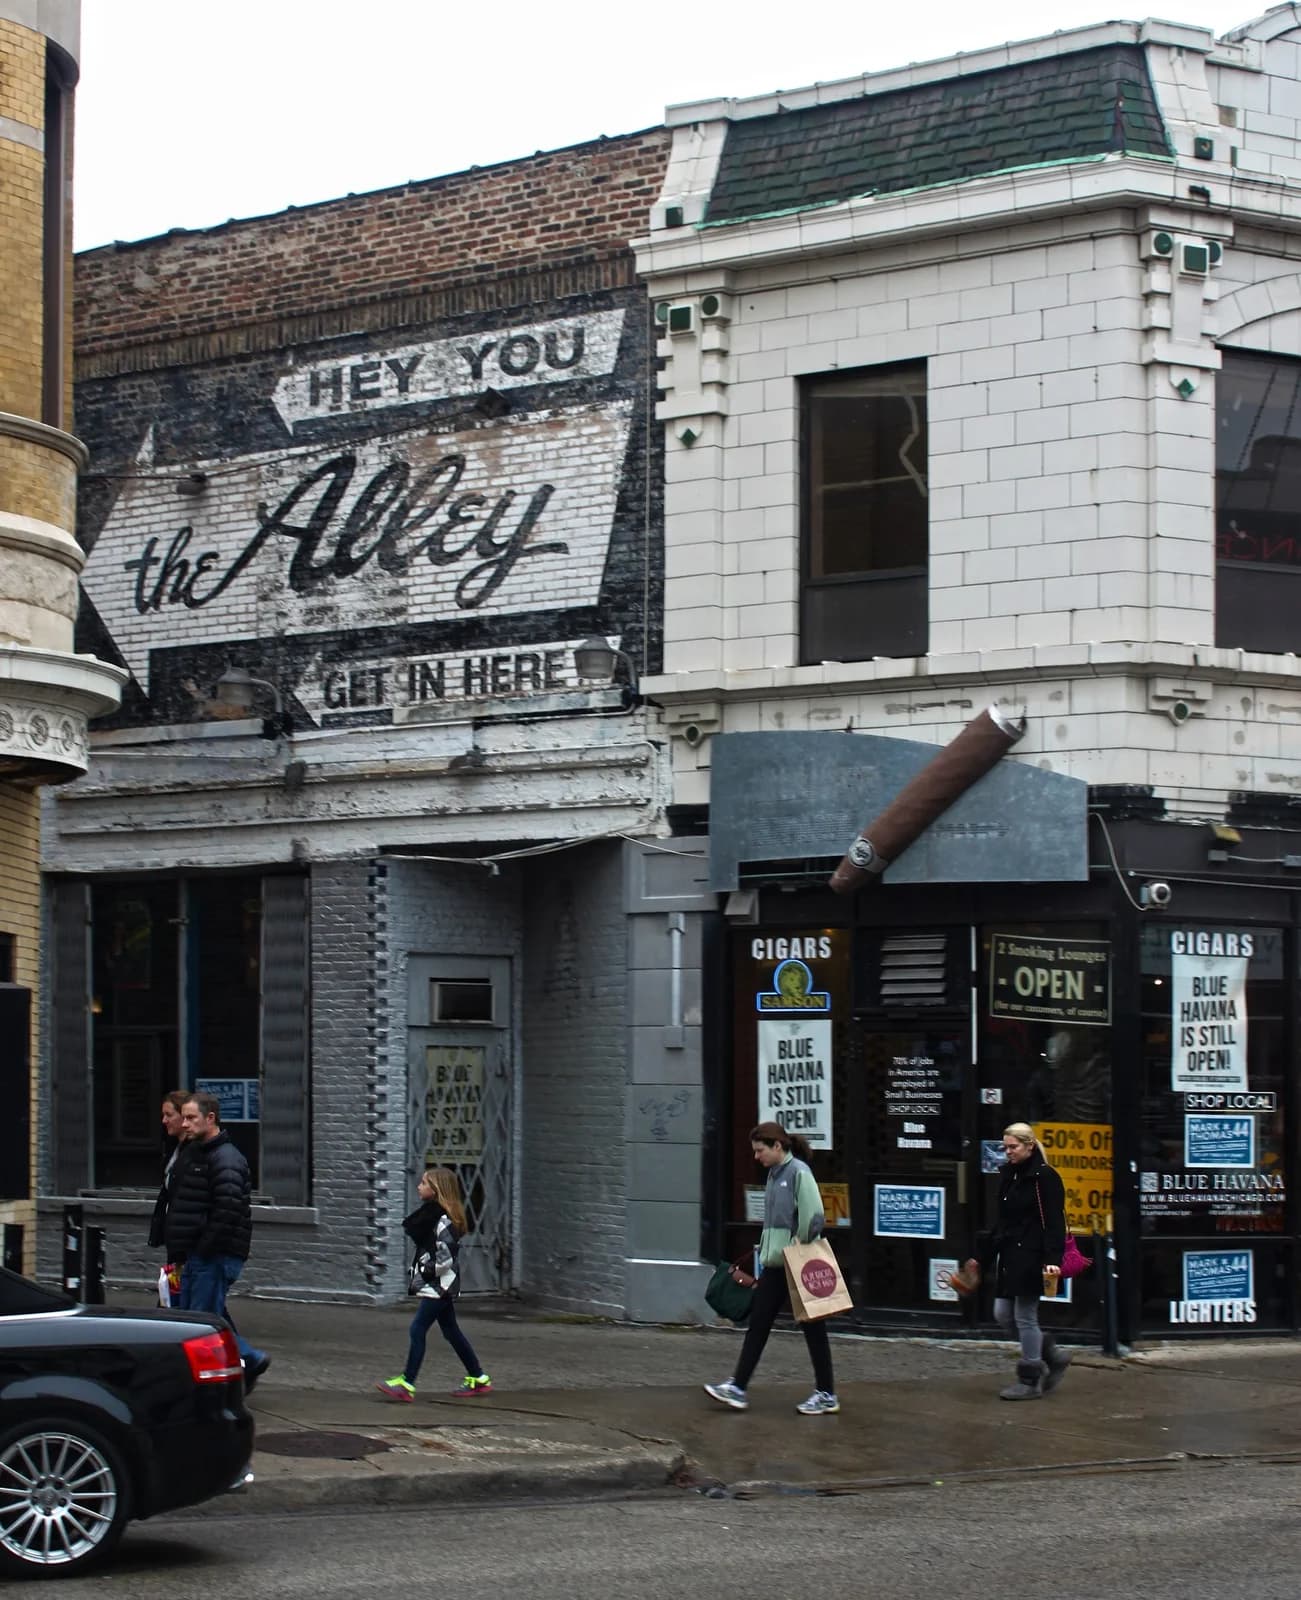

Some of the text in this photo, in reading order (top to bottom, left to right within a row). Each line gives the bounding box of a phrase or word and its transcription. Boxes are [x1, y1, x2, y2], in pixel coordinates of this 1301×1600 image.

[308, 327, 587, 408] HEY YOU
[124, 453, 570, 615] the Alley
[324, 665, 394, 710] GET
[409, 660, 446, 701] IN
[751, 936, 832, 960] CIGARS
[997, 942, 1107, 963] 2 Smoking Lounges
[1171, 930, 1254, 956] CIGARS
[1014, 966, 1085, 1000] OPEN
[1193, 976, 1228, 997] BLUE
[1181, 1000, 1237, 1022] HAVANA
[1181, 1024, 1236, 1047] IS STILL
[778, 1037, 814, 1060] BLUE
[767, 1060, 824, 1084] HAVANA
[1187, 1049, 1231, 1072] OPEN!
[768, 1085, 823, 1108] IS STILL
[1186, 1094, 1273, 1109] SHOP LOCAL
[775, 1109, 817, 1130] OPEN!
[1043, 1128, 1085, 1150] 50%
[1162, 1174, 1285, 1190] BLUE HAVANA
[1169, 1300, 1257, 1323] LIGHTERS
